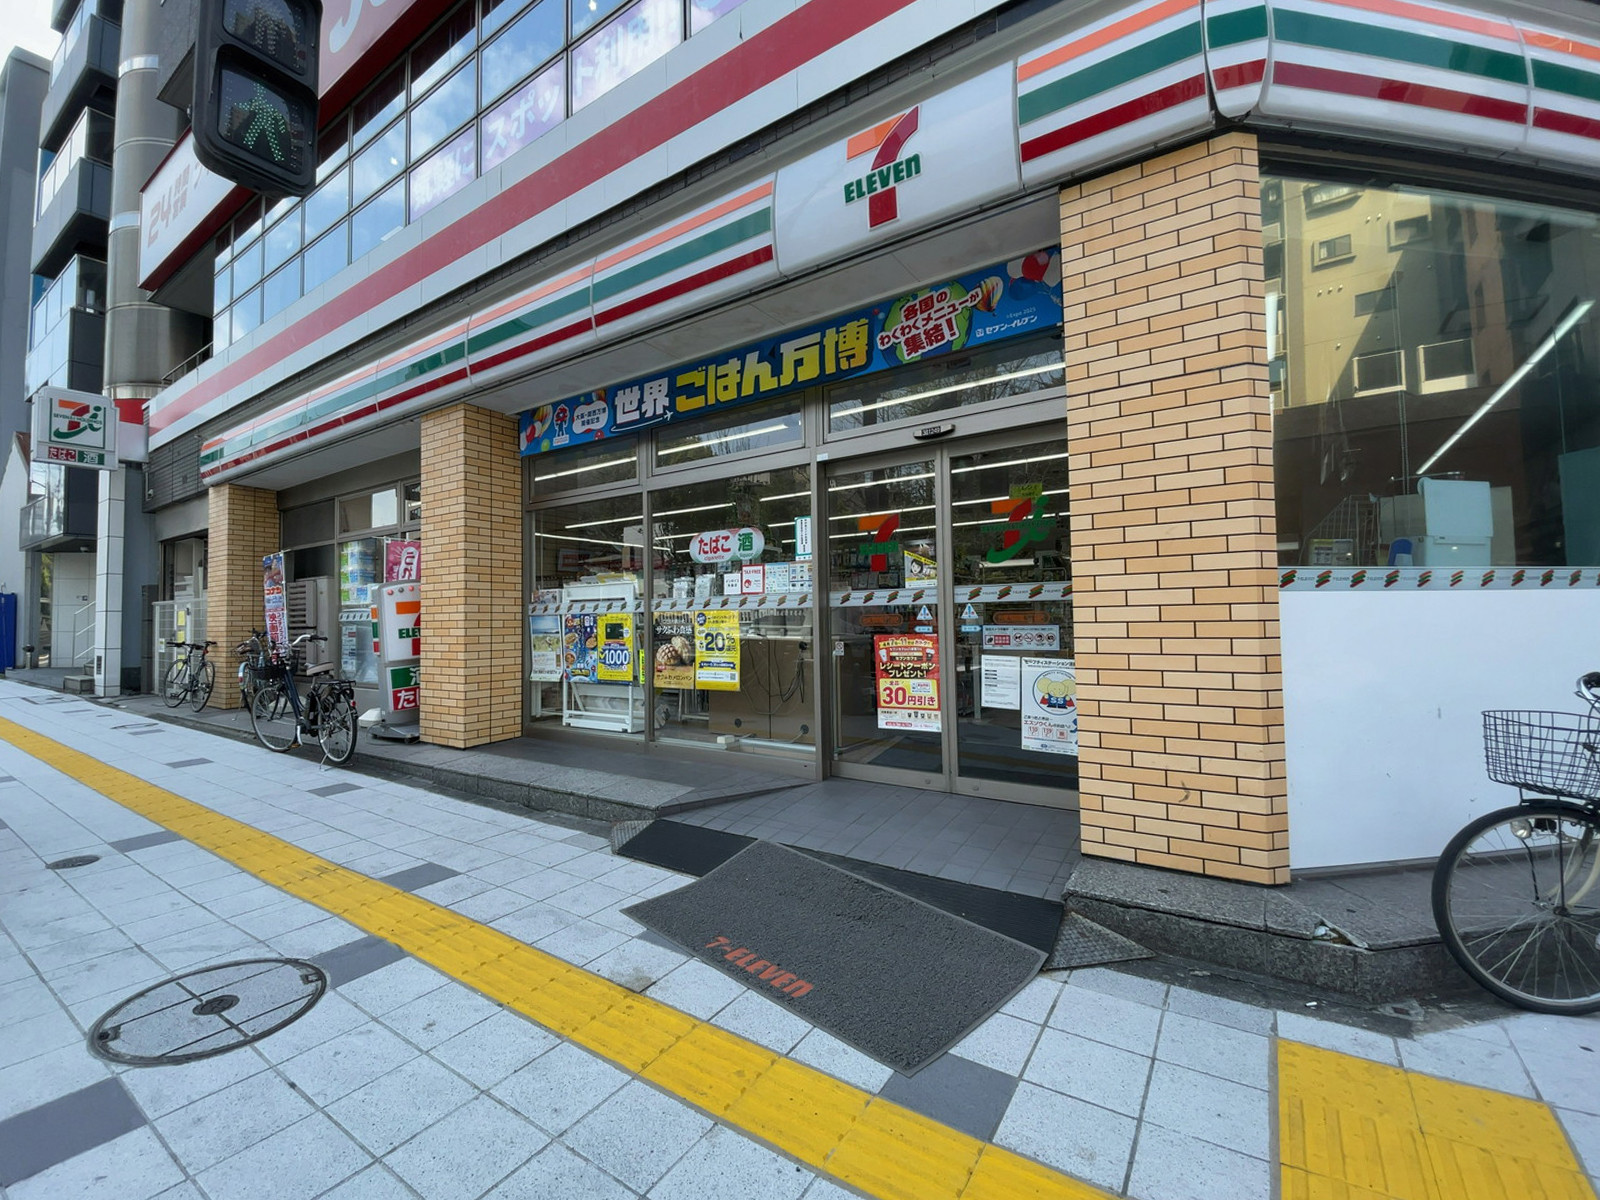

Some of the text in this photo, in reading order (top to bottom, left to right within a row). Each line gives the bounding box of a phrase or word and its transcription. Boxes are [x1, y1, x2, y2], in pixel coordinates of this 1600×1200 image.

[878, 291, 980, 347] わくわくメニューが
[904, 290, 948, 321] 各国の
[615, 318, 869, 424] 世界 ごはん万博
[49, 447, 98, 464] たばこ 酒
[698, 532, 753, 555] たばこ 酒
[880, 662, 936, 670] レシートクーポン
